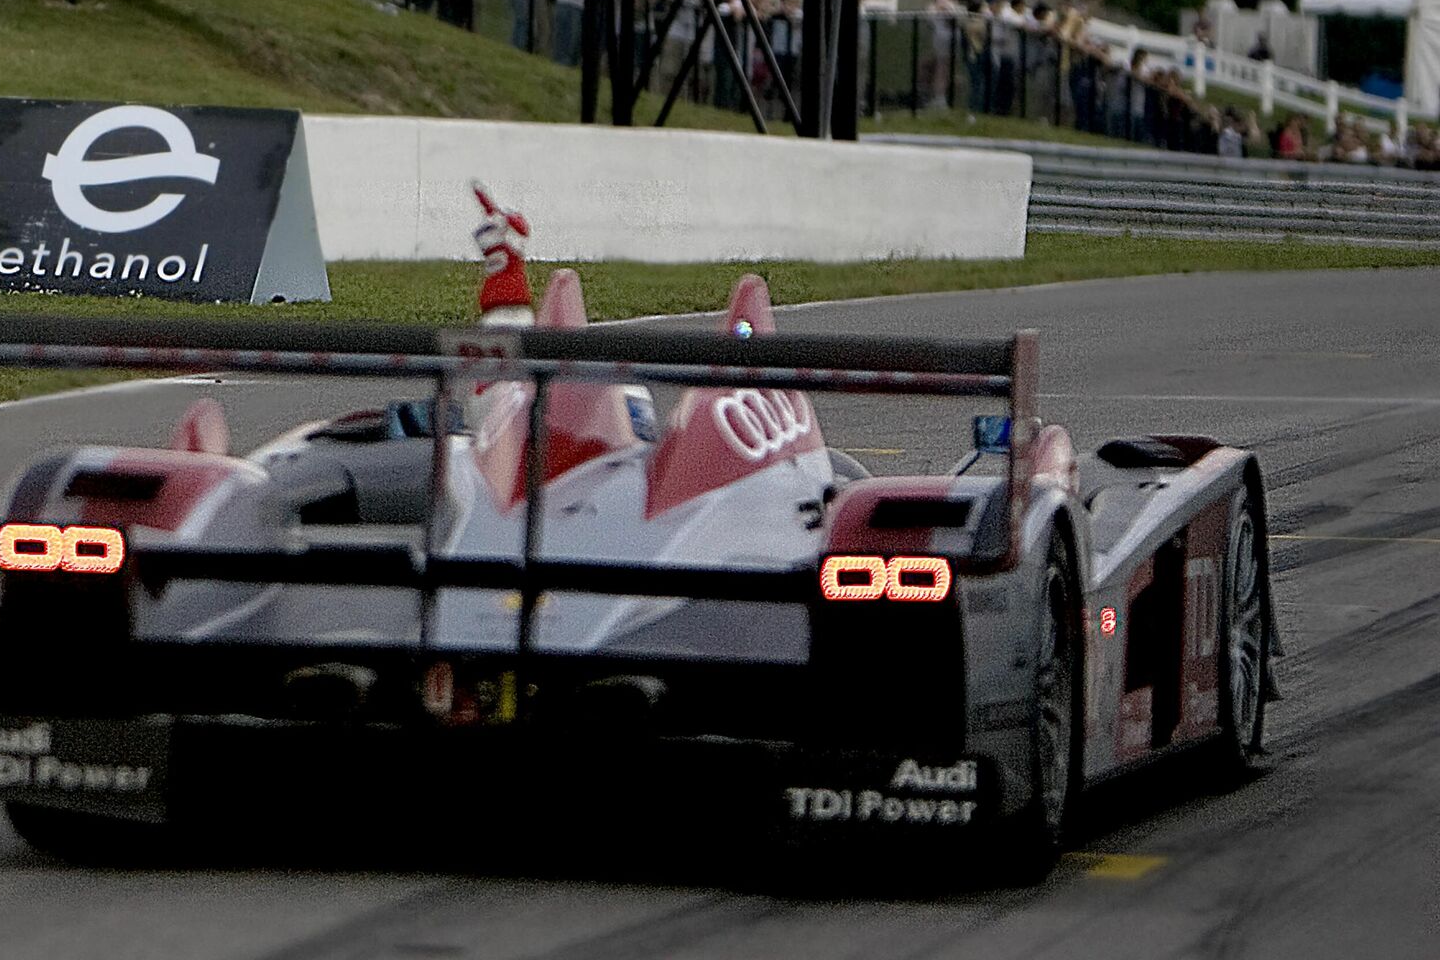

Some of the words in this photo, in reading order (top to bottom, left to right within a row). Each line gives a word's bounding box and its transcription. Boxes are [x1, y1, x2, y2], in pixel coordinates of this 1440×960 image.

[35, 755, 153, 789] Power
[890, 758, 978, 790] Audi
[784, 787, 852, 821] TDI
[858, 789, 978, 824] Power
